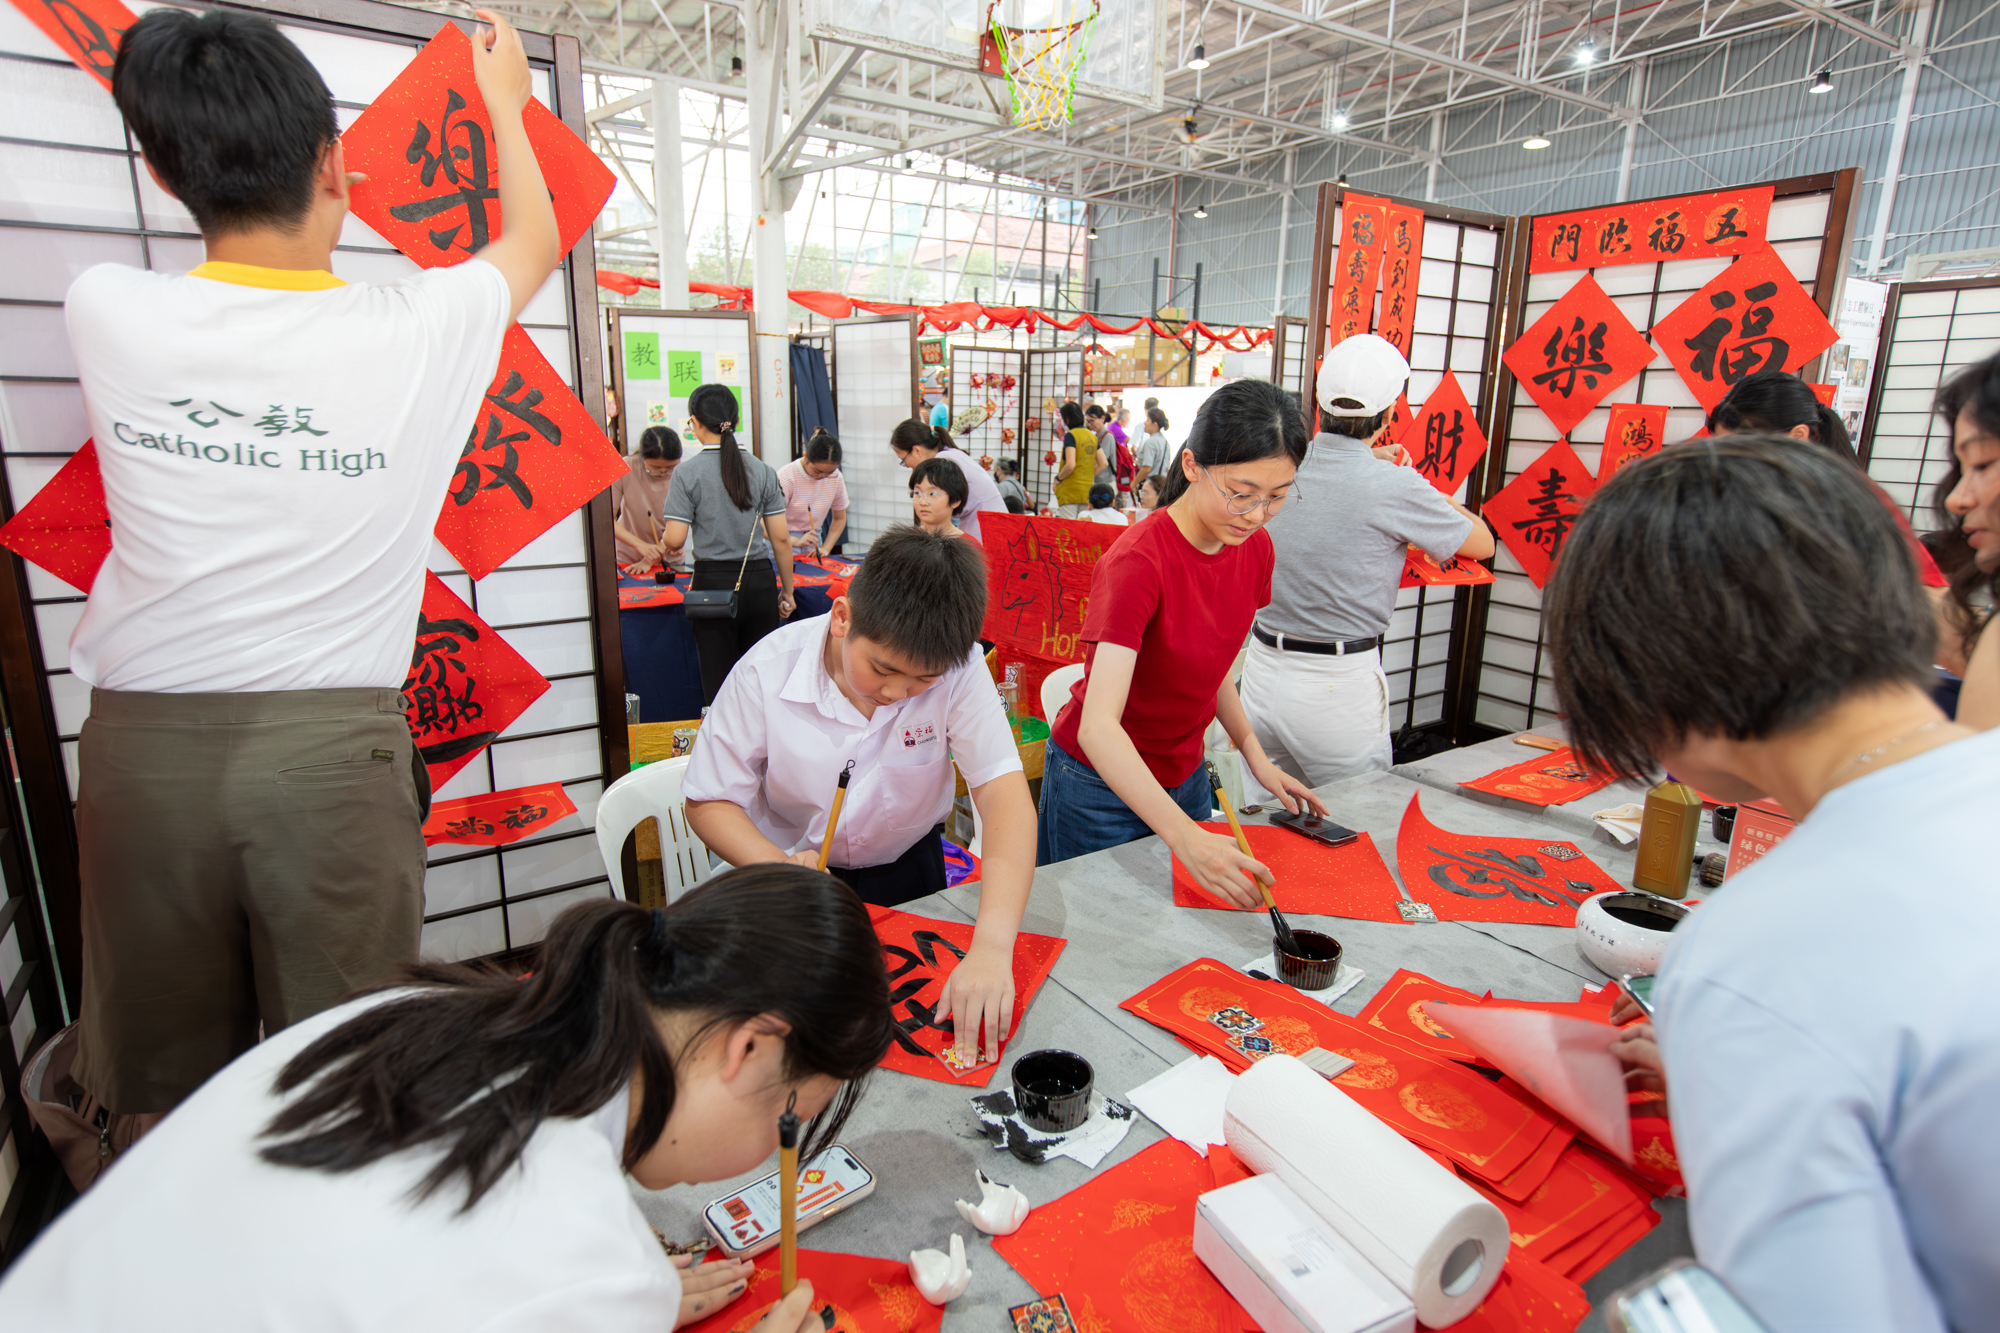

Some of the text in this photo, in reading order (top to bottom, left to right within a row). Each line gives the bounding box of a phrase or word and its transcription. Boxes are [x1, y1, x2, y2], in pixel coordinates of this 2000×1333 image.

[631, 342, 657, 367] 教
[1532, 316, 1613, 399] 樂
[1684, 281, 1790, 386] 福
[673, 360, 699, 383] 联
[168, 398, 329, 437] 公教
[1416, 409, 1464, 482] 財
[113, 421, 388, 477] Catholic High
[1512, 467, 1580, 561] 壽
[1039, 621, 1086, 660] Hor
